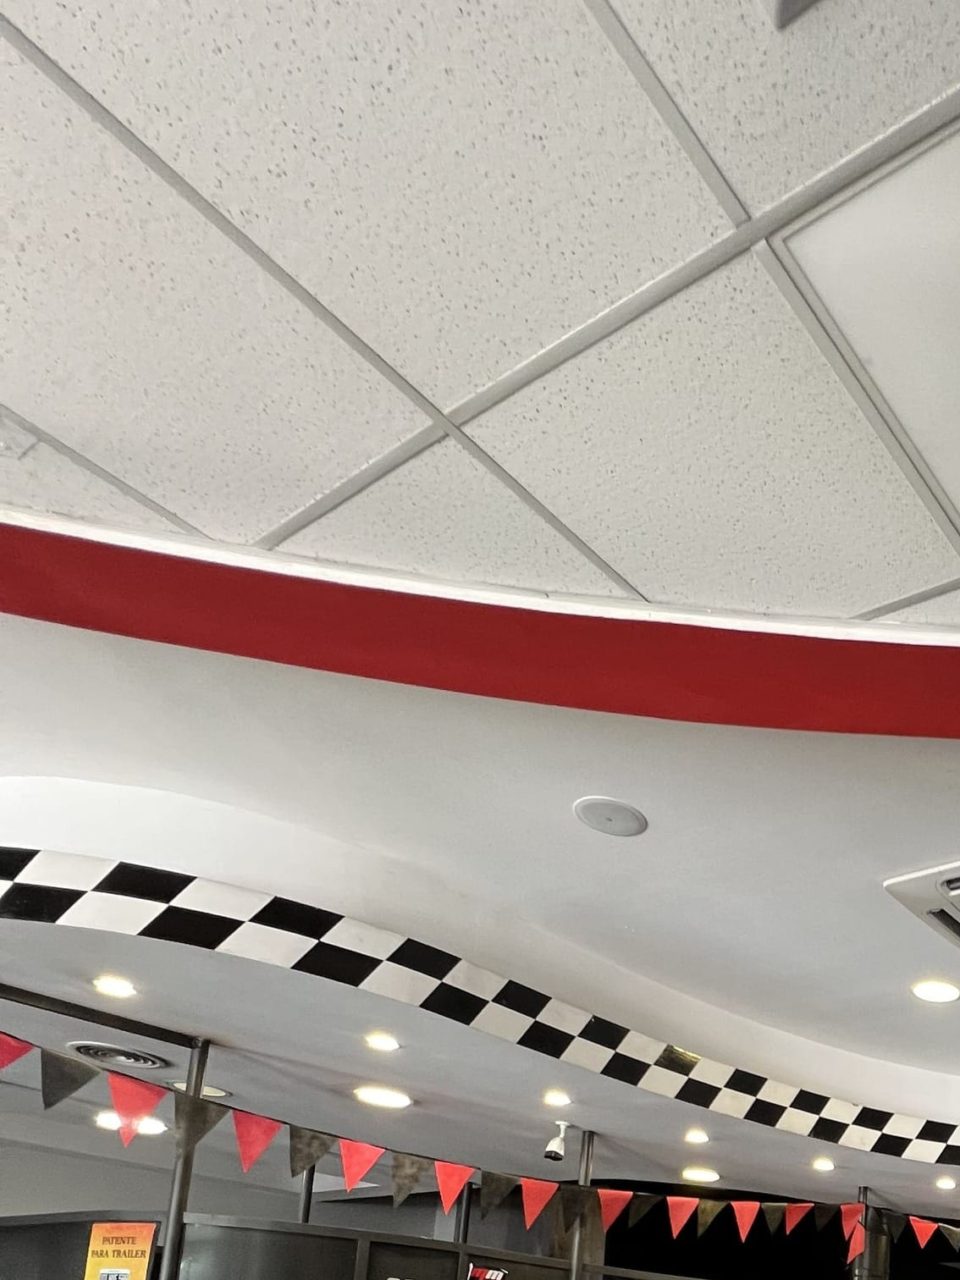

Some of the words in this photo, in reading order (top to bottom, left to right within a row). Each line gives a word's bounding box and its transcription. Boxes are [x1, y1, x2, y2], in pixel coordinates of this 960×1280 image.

[101, 1236, 137, 1246] PATENTE
[91, 1249, 109, 1259] PARA
[111, 1249, 147, 1259] TRAILER
